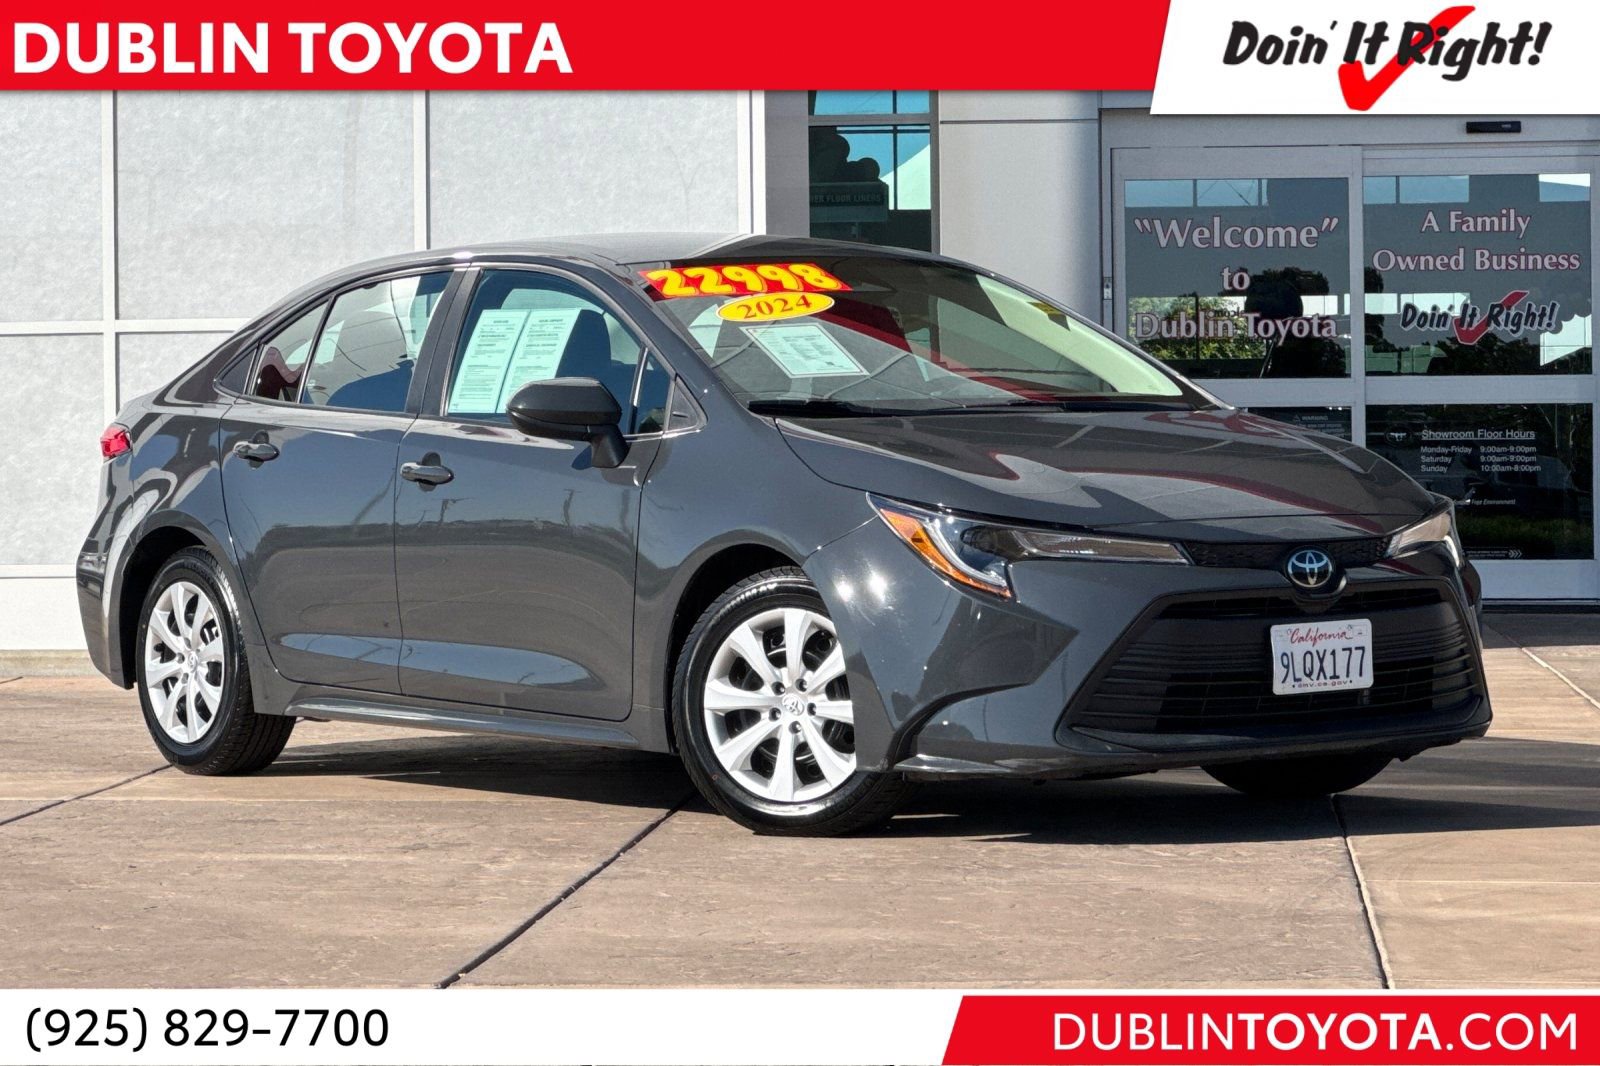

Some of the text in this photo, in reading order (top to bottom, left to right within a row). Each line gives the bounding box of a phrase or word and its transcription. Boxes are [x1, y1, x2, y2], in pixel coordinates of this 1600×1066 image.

[1420, 207, 1531, 239] A Family
[1372, 246, 1581, 272] Owned Business
[646, 263, 843, 296] 22998
[1220, 266, 1250, 291] to
[736, 294, 813, 320] 2024
[1400, 301, 1559, 335] Doin' It Right!
[1135, 312, 1337, 347] Dublin Toyota
[1421, 429, 1536, 440] Showroom Floor Hours
[1420, 445, 1537, 454] Monday-Friday 9:00am-9:00pm
[1420, 455, 1537, 464] Saturday 9:00am-9:00pm
[1420, 465, 1449, 473] Sunday
[1289, 627, 1354, 648] California
[1280, 646, 1366, 684] 9LQX177
